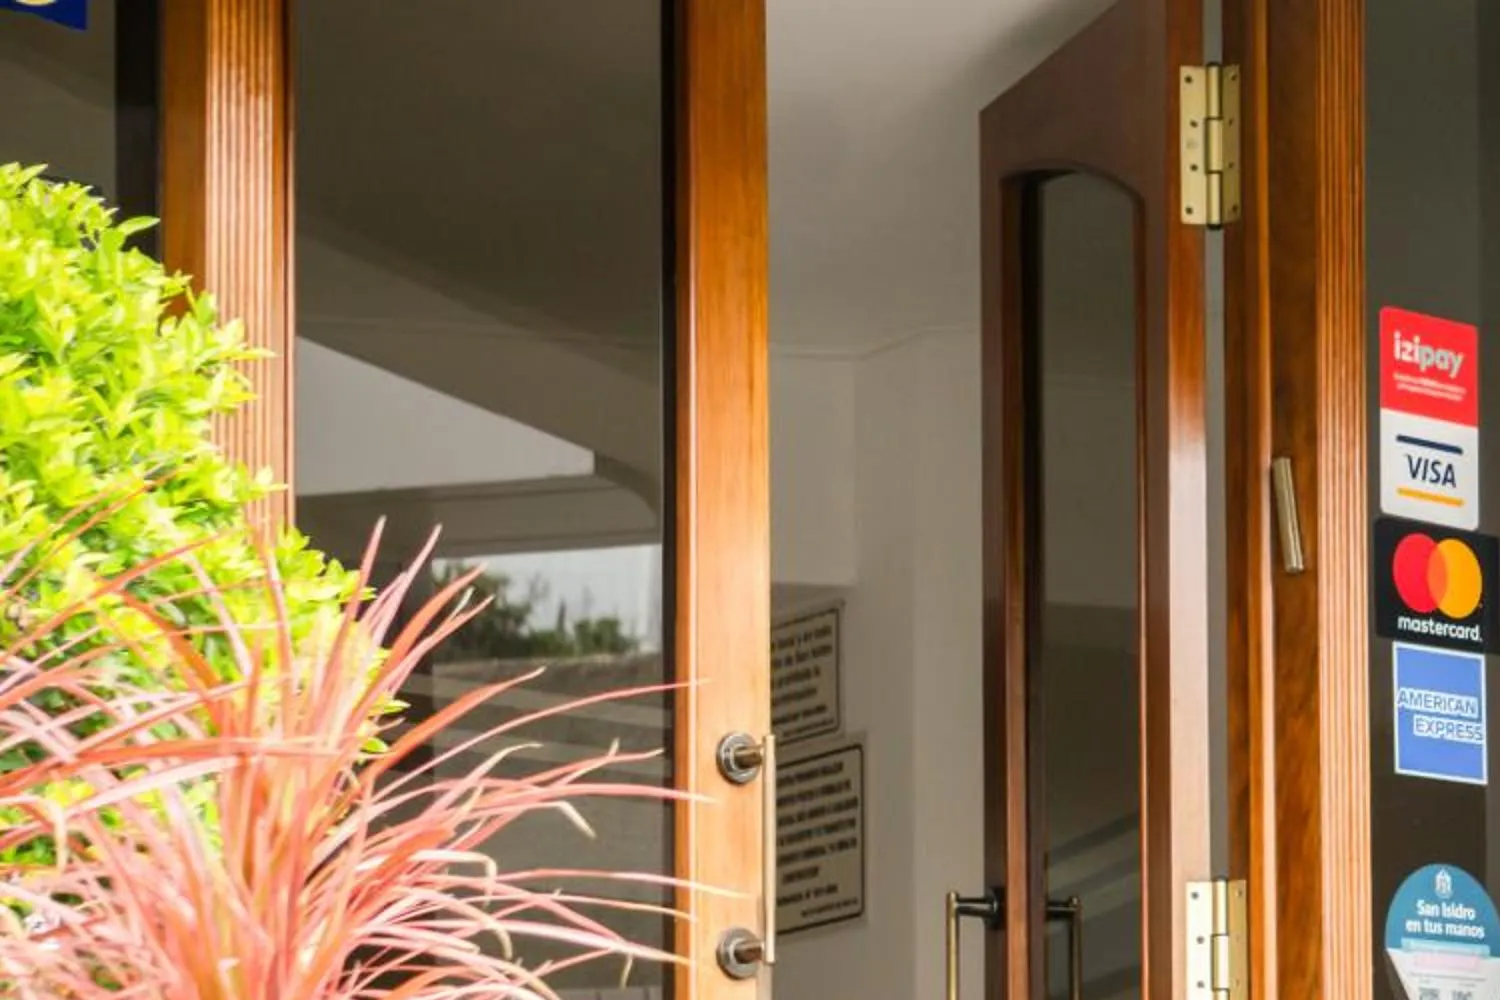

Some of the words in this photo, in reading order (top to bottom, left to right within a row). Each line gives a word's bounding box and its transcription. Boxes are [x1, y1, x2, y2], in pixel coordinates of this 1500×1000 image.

[1393, 331, 1464, 378] izipay
[1406, 453, 1457, 488] VISA
[1397, 689, 1476, 716] AMERICAN
[1415, 717, 1483, 741] EXPRESS
[1416, 899, 1439, 917] San
[1405, 919, 1421, 933] en
